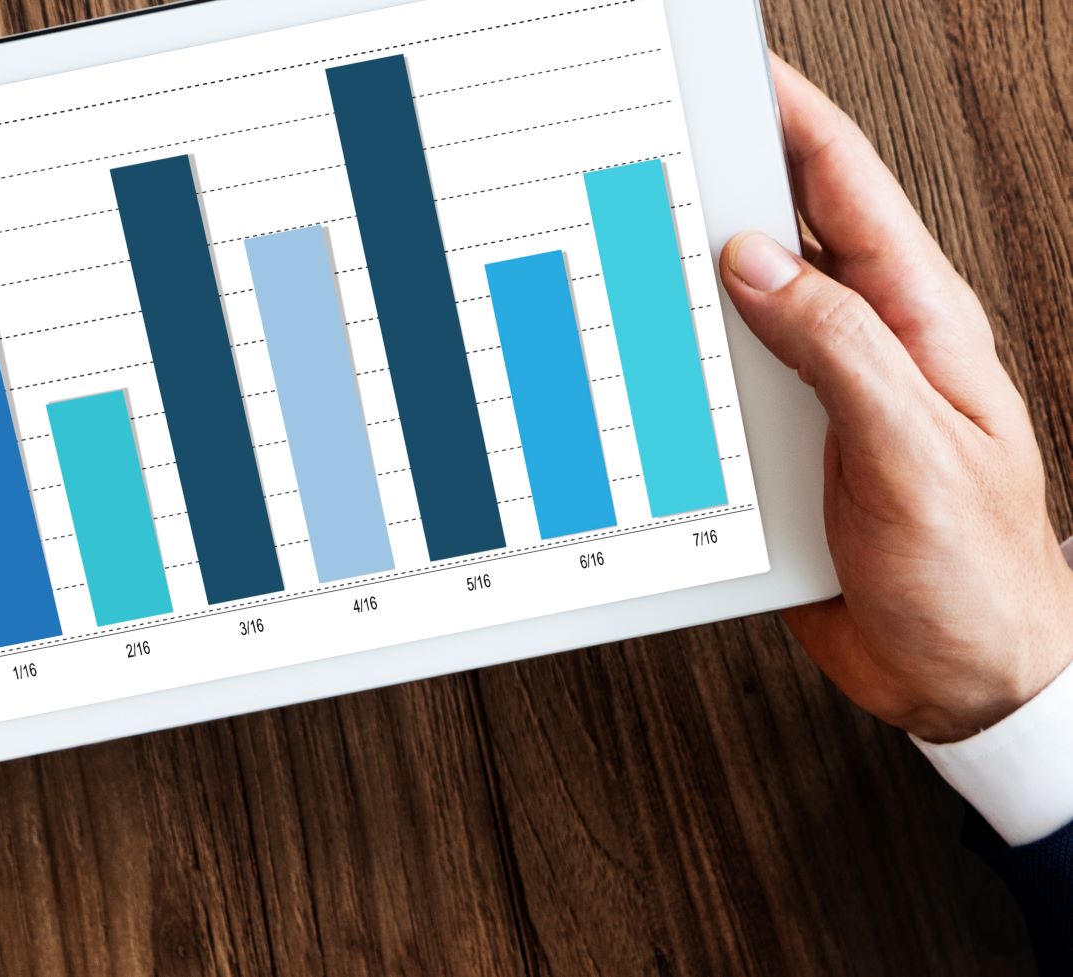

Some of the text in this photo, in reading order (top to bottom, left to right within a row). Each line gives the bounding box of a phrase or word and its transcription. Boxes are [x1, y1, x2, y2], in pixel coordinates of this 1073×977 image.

[692, 529, 719, 548] 7/16
[579, 551, 605, 570] 6/16
[466, 573, 492, 592] 5/16
[353, 595, 378, 614] 4/16
[239, 618, 264, 636] 3/16
[125, 640, 151, 659] 2/16
[12, 662, 38, 681] 1/16
